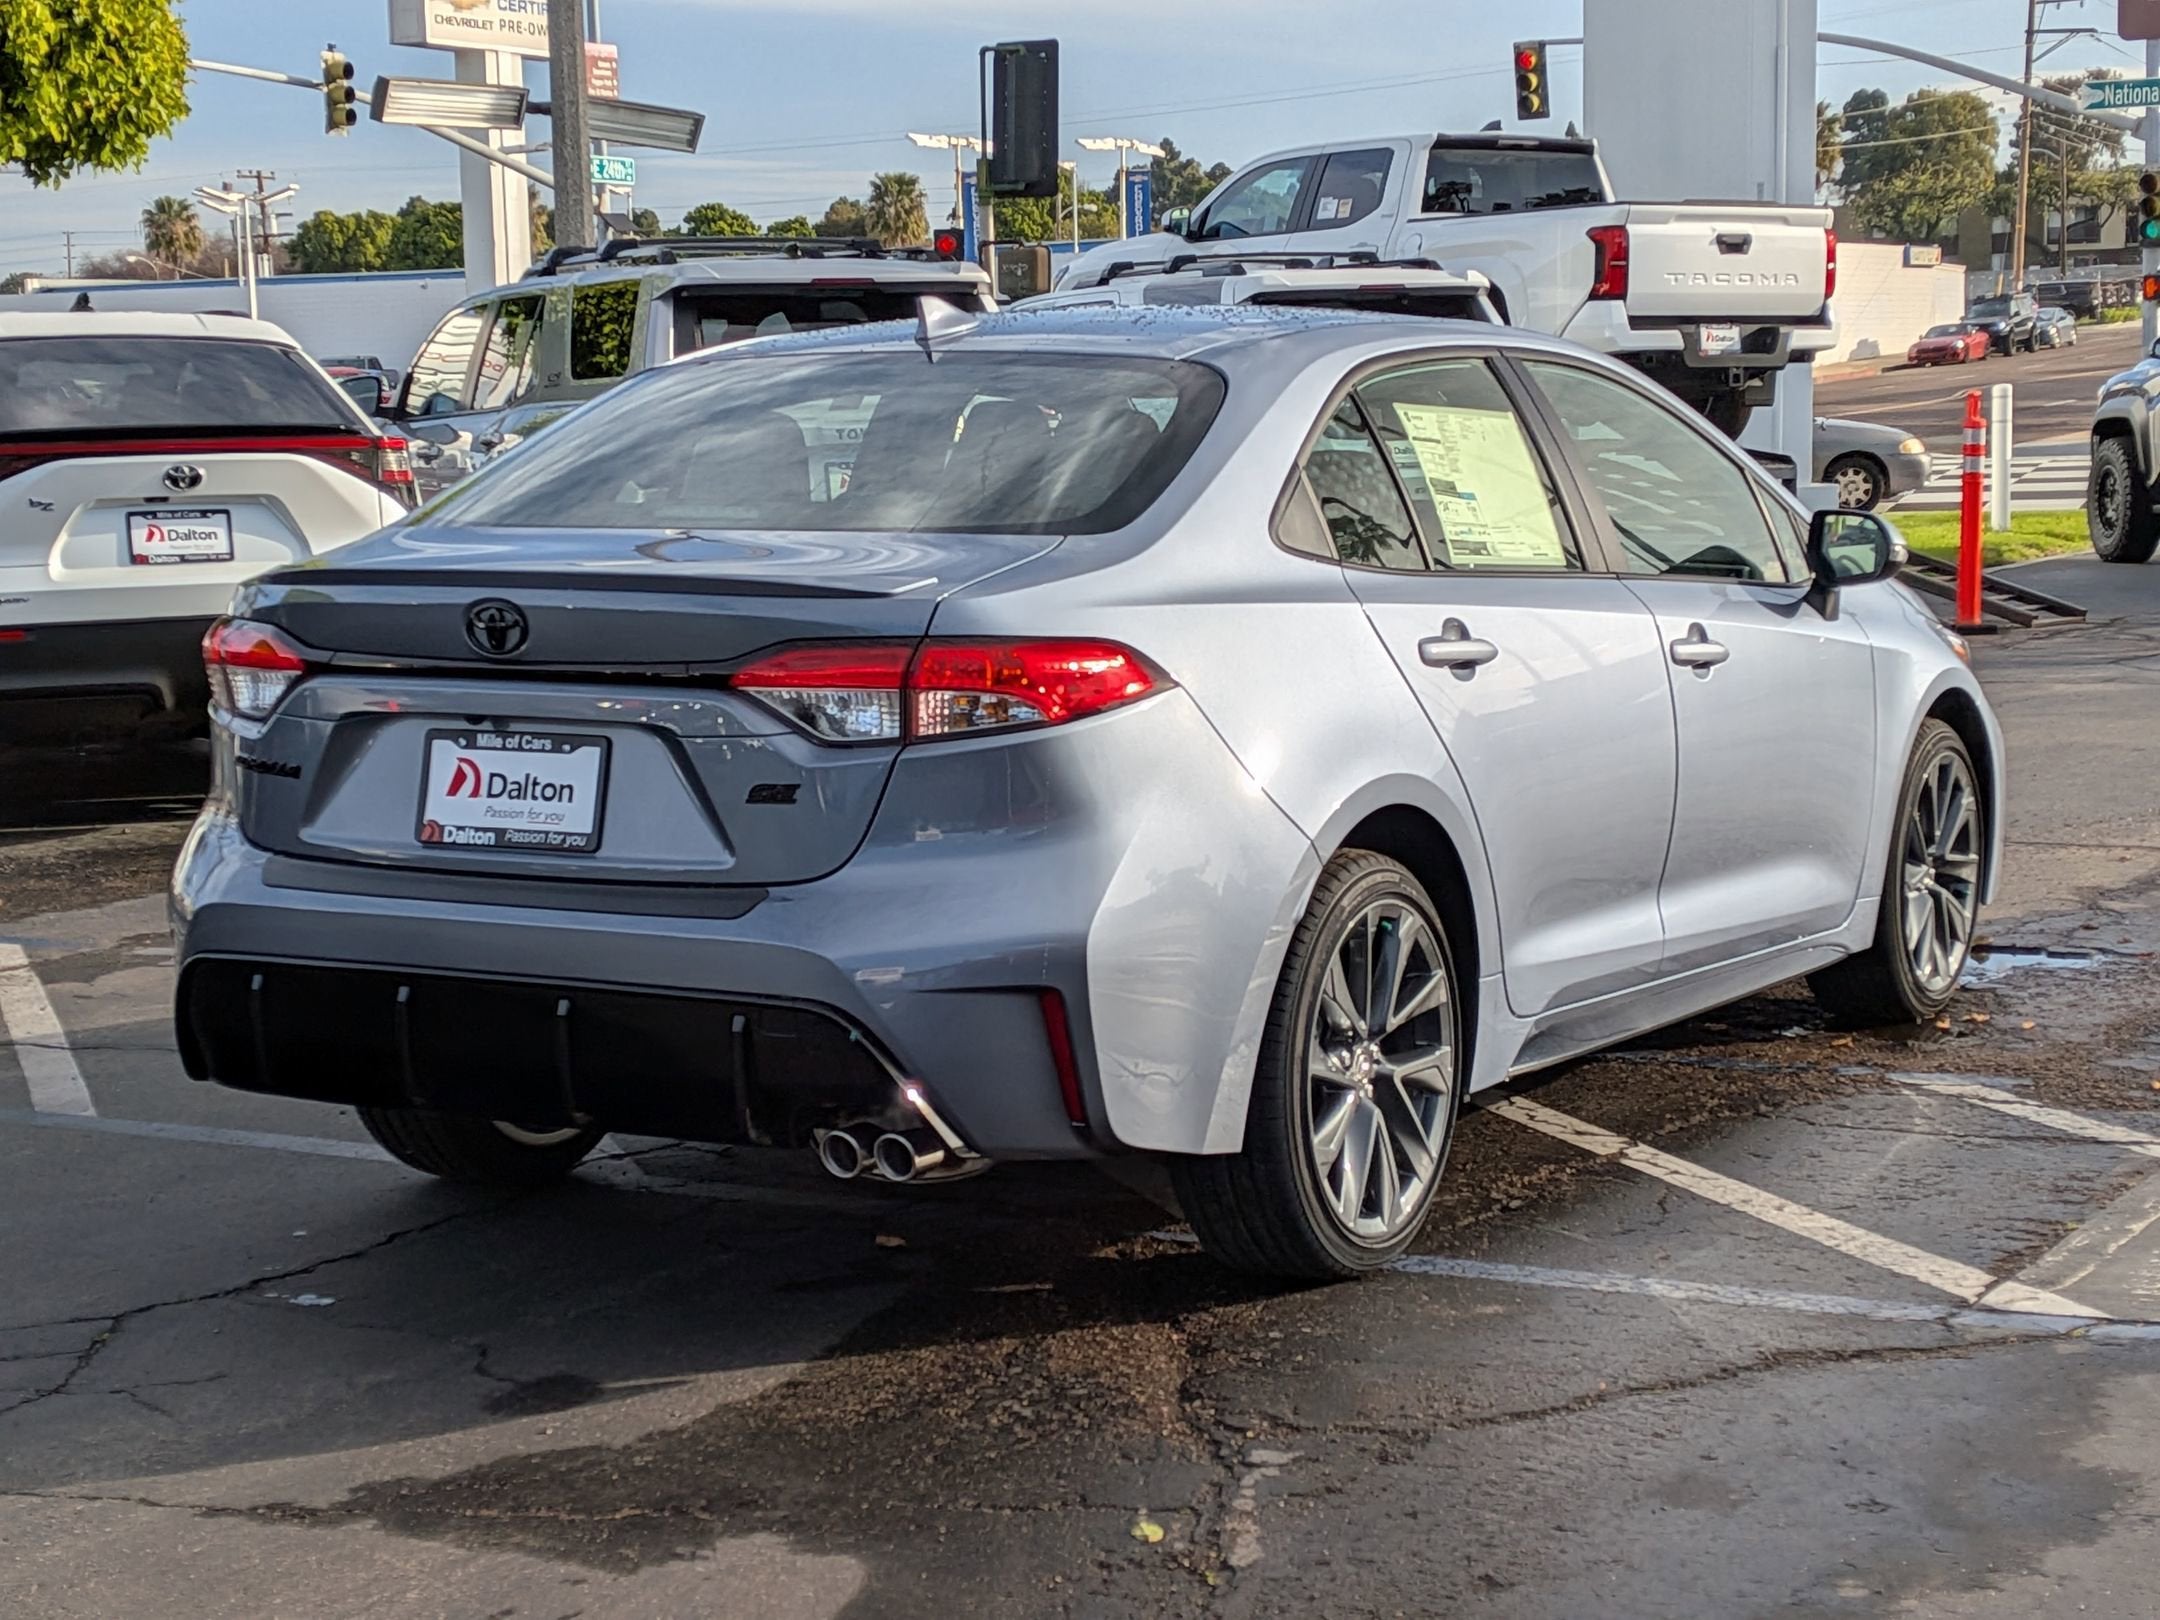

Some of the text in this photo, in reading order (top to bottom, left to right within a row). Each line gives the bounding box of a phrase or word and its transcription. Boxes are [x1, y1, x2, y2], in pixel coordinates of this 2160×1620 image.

[434, 14, 494, 30] CHEVROLET
[2104, 83, 2160, 106] Nationa
[1664, 272, 1799, 286] TACOMA
[167, 529, 218, 541] Dalton
[149, 554, 181, 564] Dalton
[476, 733, 552, 750] Mile of Cars
[486, 772, 574, 803] Dalton
[484, 806, 565, 823] Passion for you
[443, 825, 496, 845] Dalton
[504, 829, 588, 847] Passion for you
